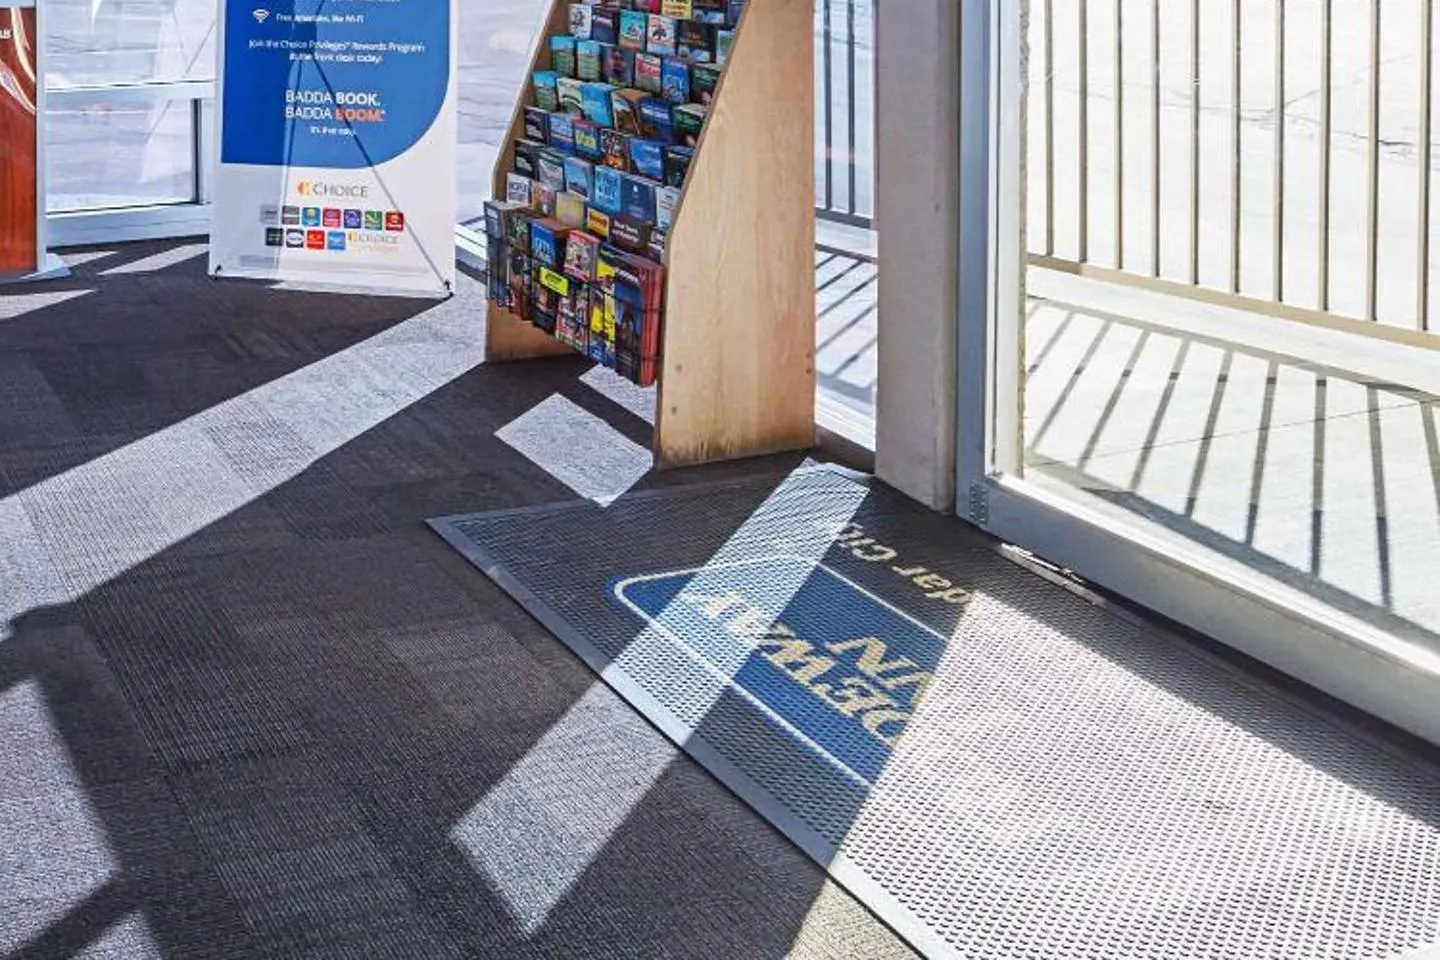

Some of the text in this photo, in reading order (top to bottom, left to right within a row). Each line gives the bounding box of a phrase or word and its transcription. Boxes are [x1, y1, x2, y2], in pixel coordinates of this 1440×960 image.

[280, 41, 308, 49] Choice
[285, 91, 380, 106] BADDA BOOK.
[285, 107, 332, 119] BADDA
[312, 182, 368, 198] CHOICE
